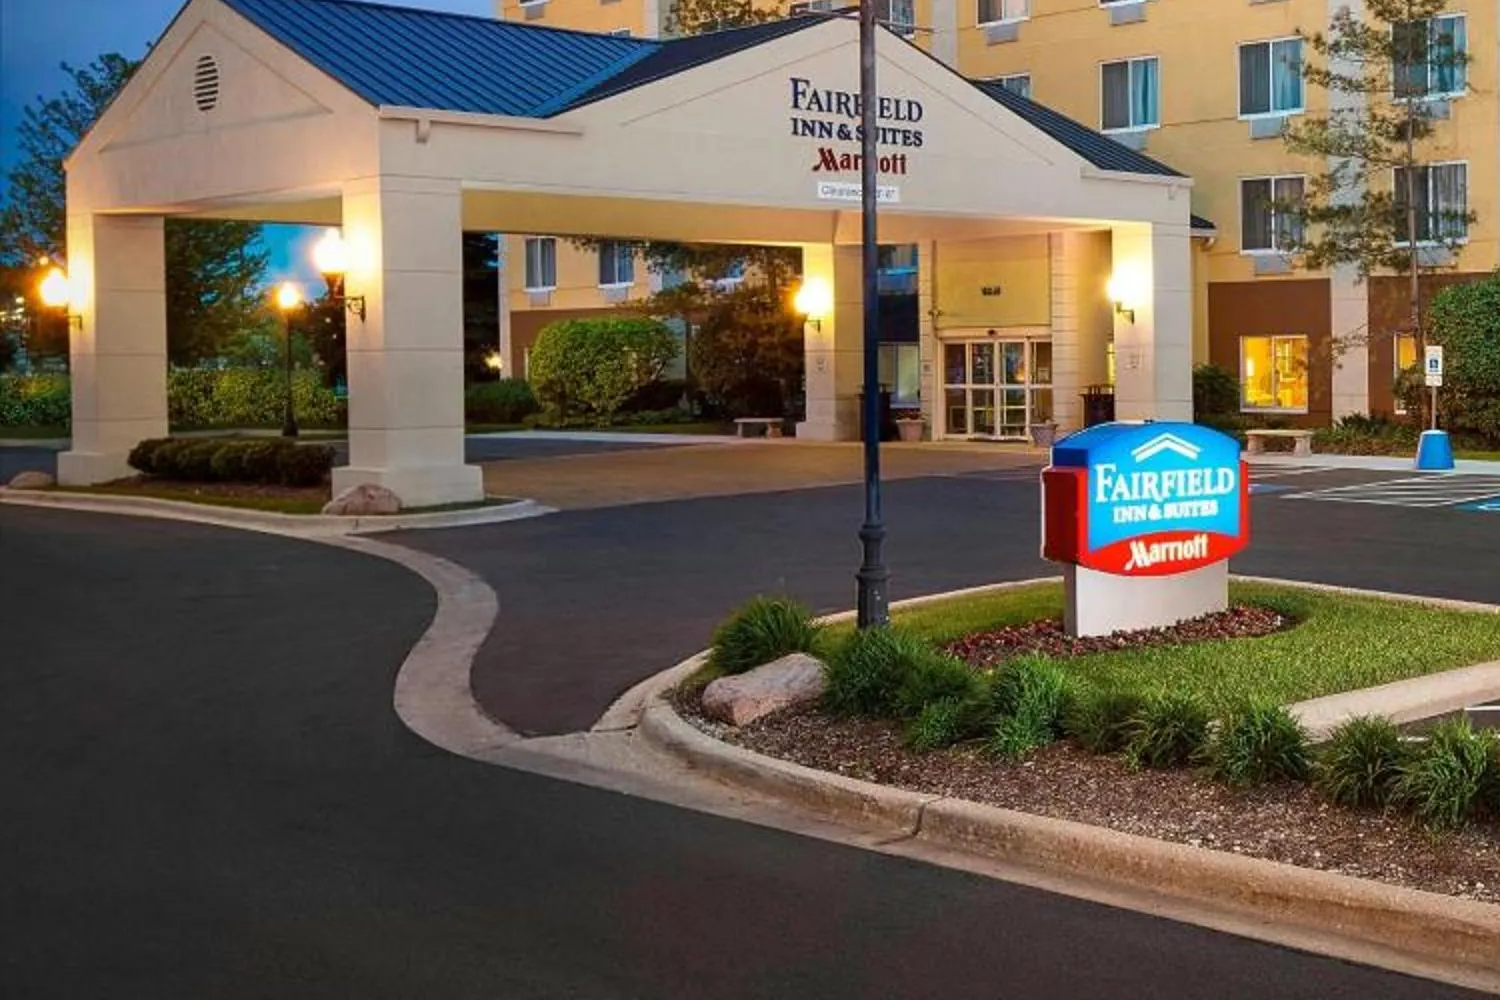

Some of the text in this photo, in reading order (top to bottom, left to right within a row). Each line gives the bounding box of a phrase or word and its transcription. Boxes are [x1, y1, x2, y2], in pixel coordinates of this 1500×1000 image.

[790, 77, 923, 122] FAIRFELD
[790, 117, 923, 147] INN & SITES
[812, 147, 907, 174] Marott
[1094, 464, 1235, 503] FAIRFIELD
[1113, 505, 1147, 524] INN
[1163, 499, 1219, 520] SUITES
[1124, 533, 1210, 571] Marriott
